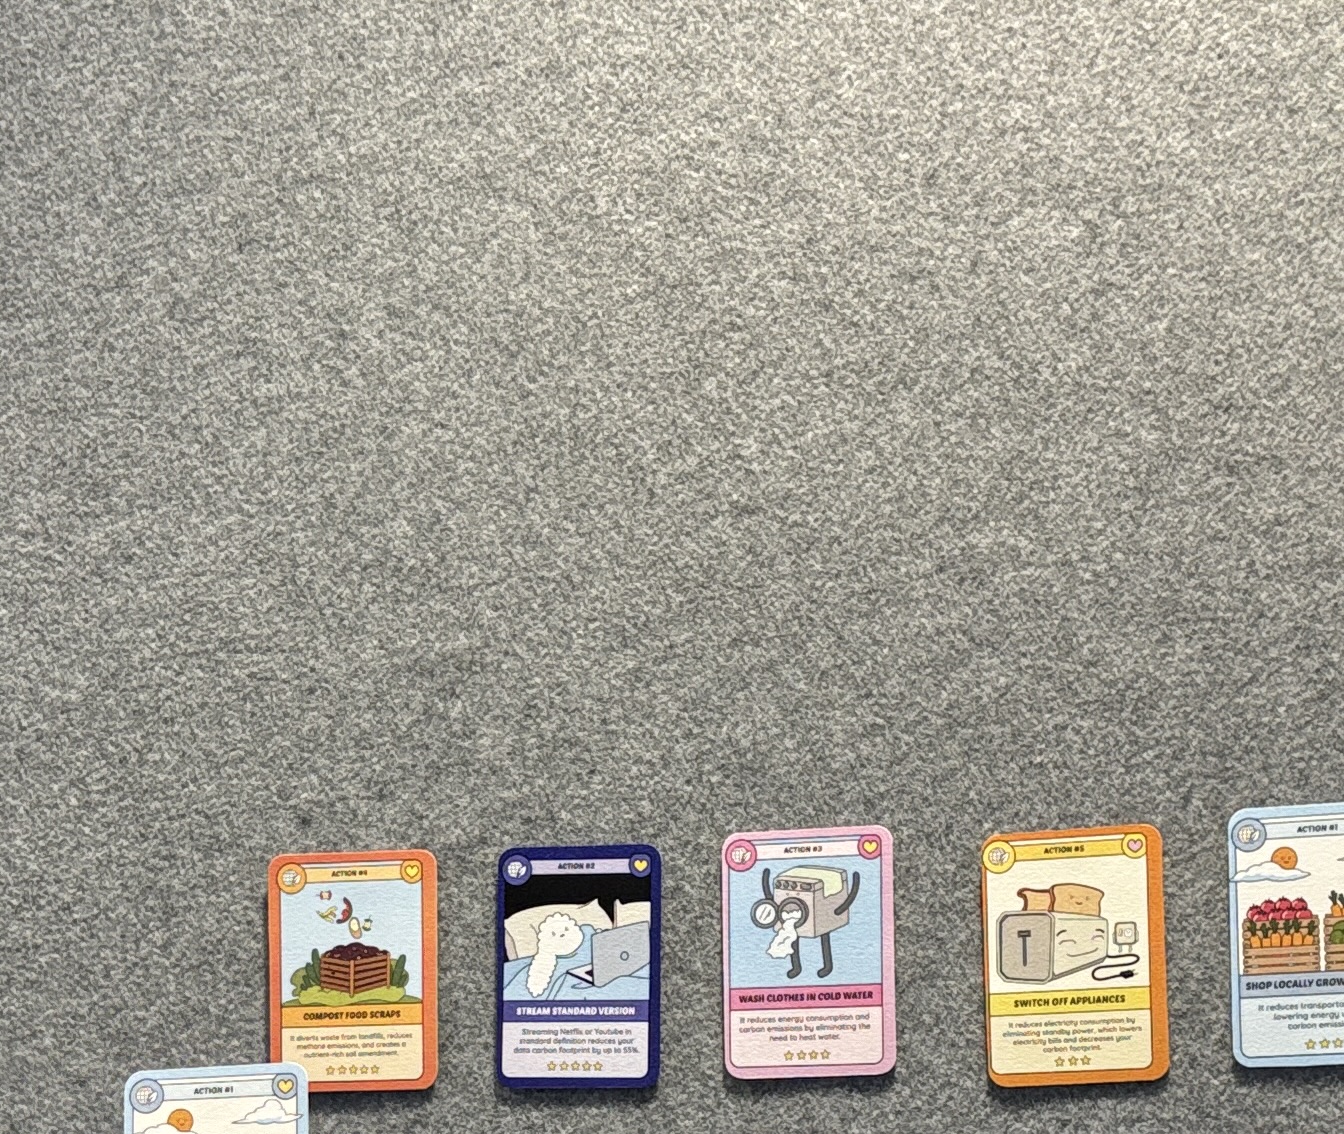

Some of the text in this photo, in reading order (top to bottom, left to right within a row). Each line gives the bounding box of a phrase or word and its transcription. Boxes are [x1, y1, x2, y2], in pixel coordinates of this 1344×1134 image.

[1297, 825, 1327, 833] ACTION
[784, 846, 811, 854] ACTION
[1044, 846, 1072, 854] ACTION
[1246, 982, 1271, 990] SHOP
[1274, 979, 1314, 988] LOCALLY
[739, 991, 873, 1003] WASH CLOTHES IN COLD WATER
[1014, 995, 1125, 1007] SWITCH OFF APPLIANCES
[516, 1007, 635, 1015] STREAM STANDARD VERSION
[1266, 1003, 1298, 1011] reduces
[303, 1010, 401, 1020] COMPOST FOOD SCRAPS
[193, 1087, 222, 1095] ACTION
